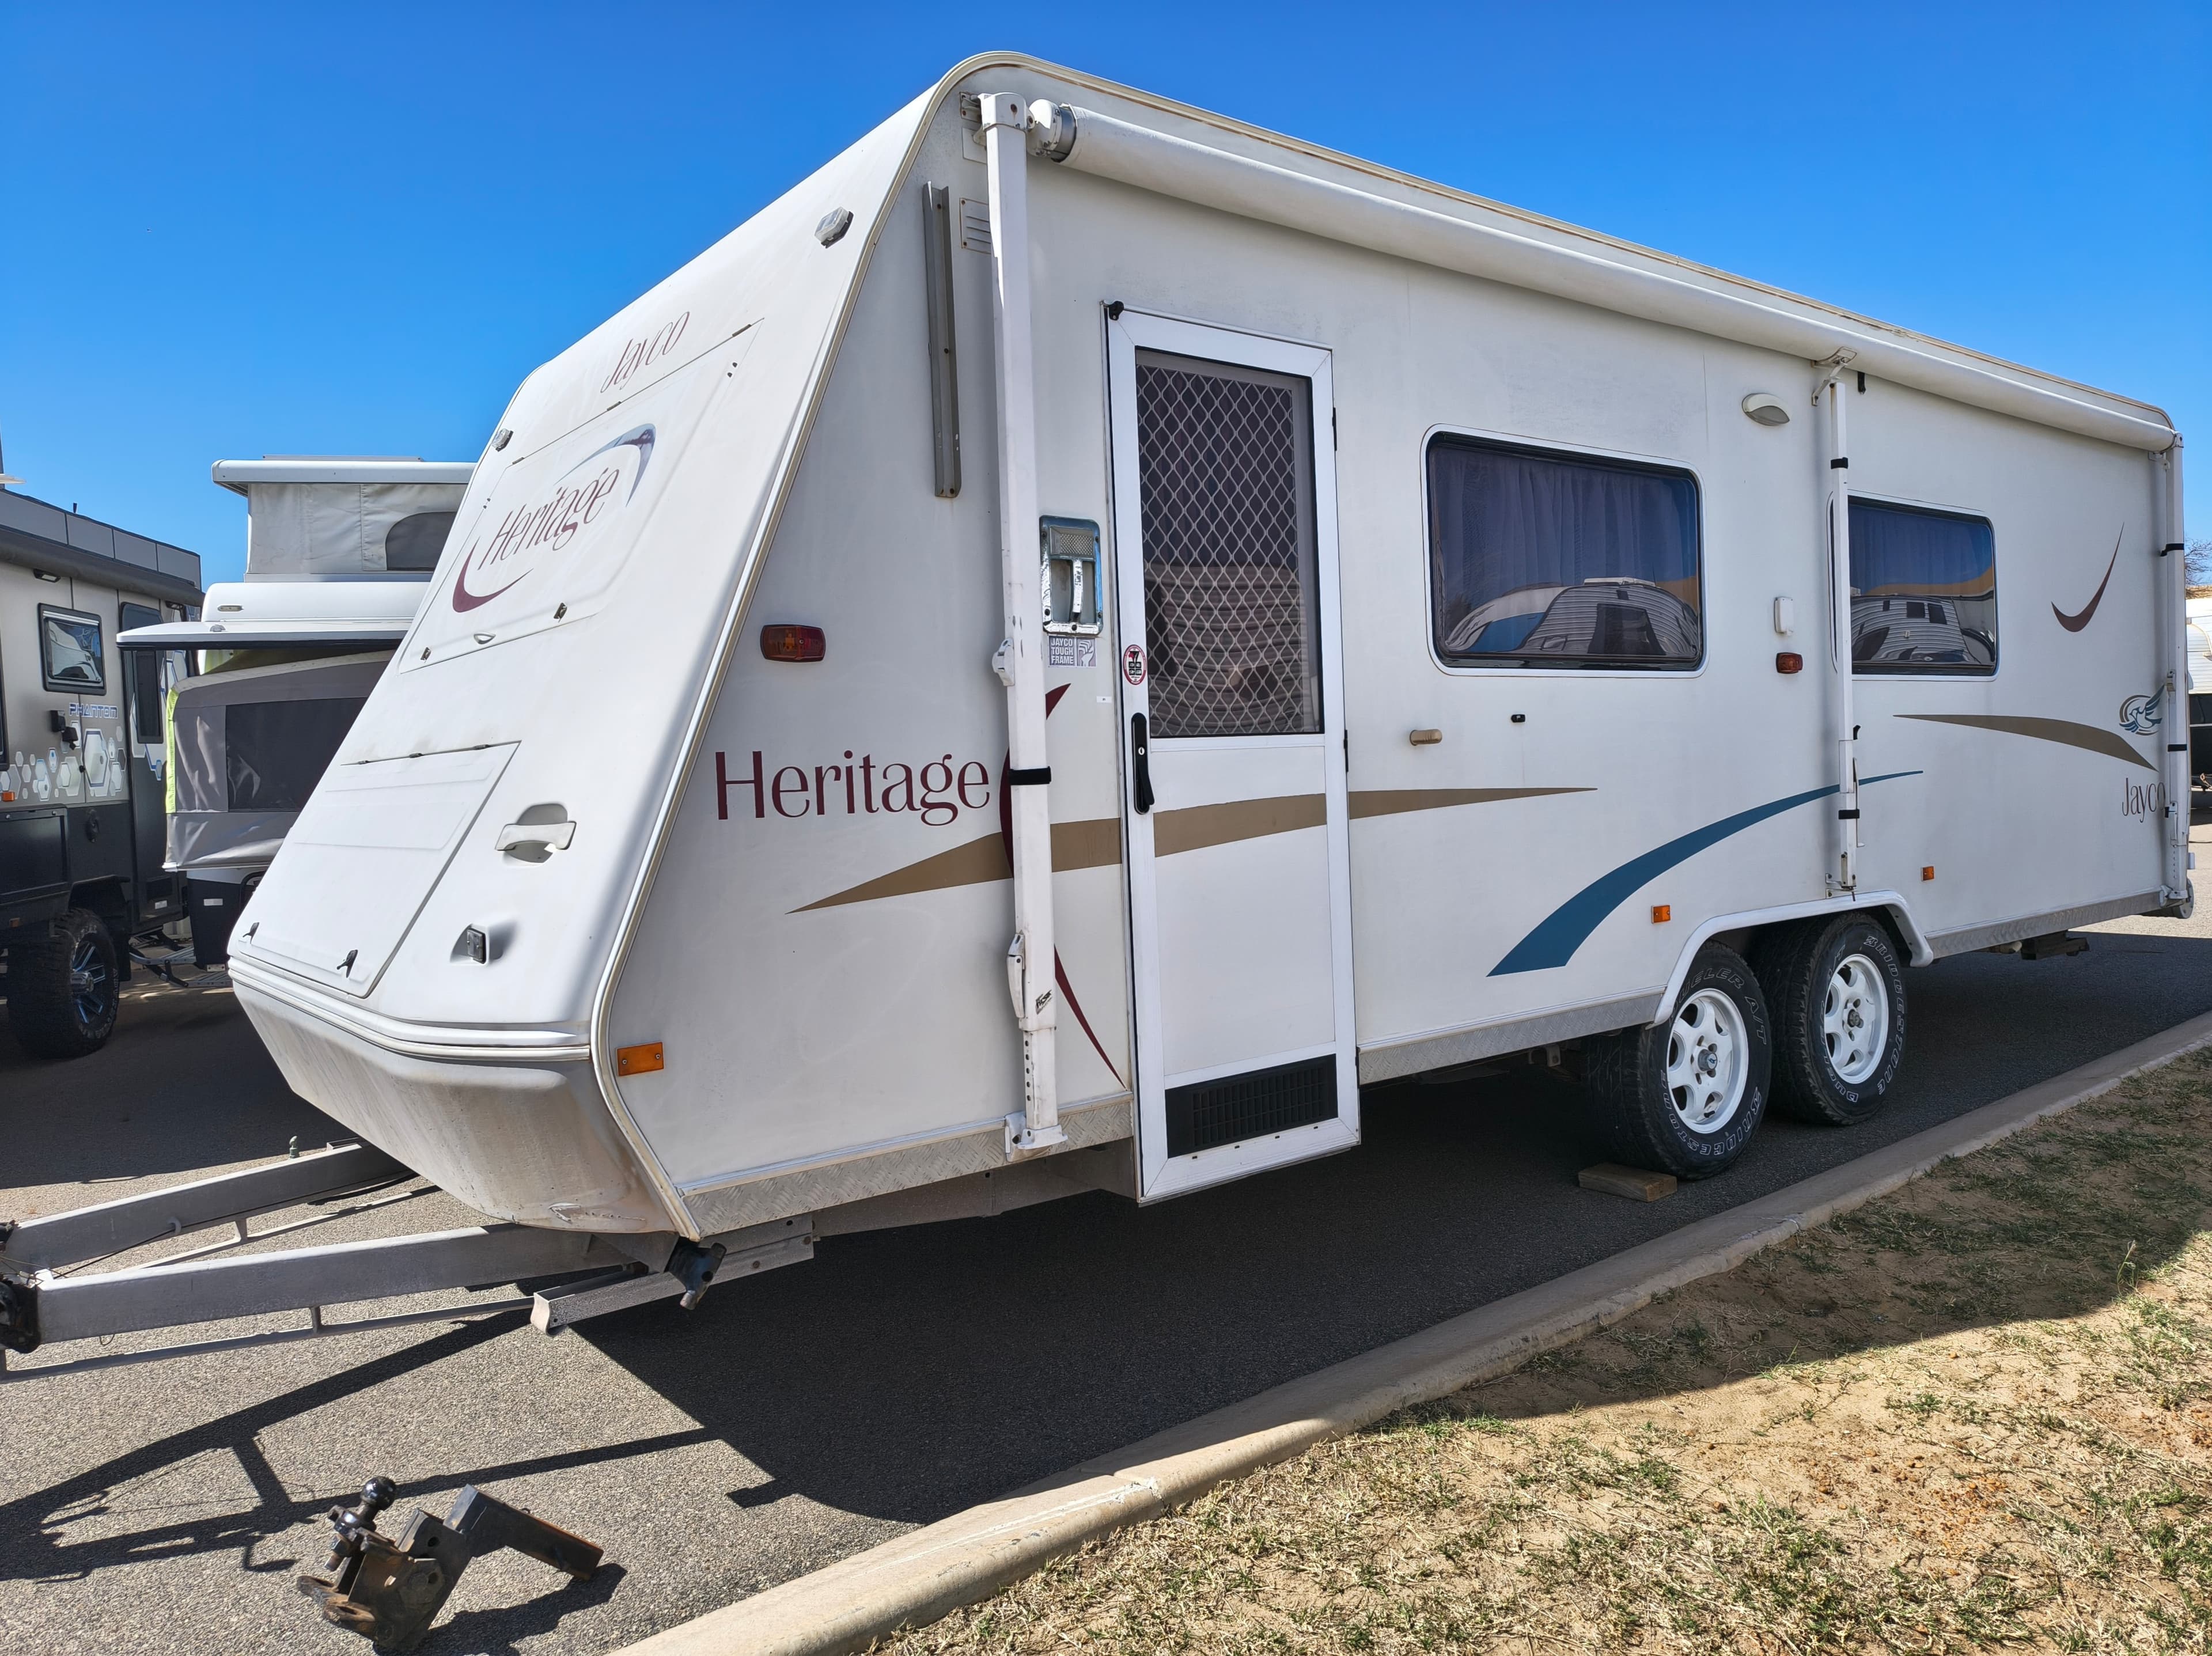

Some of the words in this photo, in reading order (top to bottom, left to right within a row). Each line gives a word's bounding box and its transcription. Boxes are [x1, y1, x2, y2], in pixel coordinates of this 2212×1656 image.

[600, 312, 690, 393] Jayco
[477, 468, 620, 571] Heritage
[1051, 637, 1073, 646] JAYCO
[1051, 647, 1074, 655] TOUGH
[1051, 655, 1074, 664] FRAME
[715, 750, 990, 826] Heritage
[2122, 777, 2166, 823] Jayco
[1745, 996, 1767, 1045] A/T
[1863, 935, 1904, 1095] BRIDGESTONE
